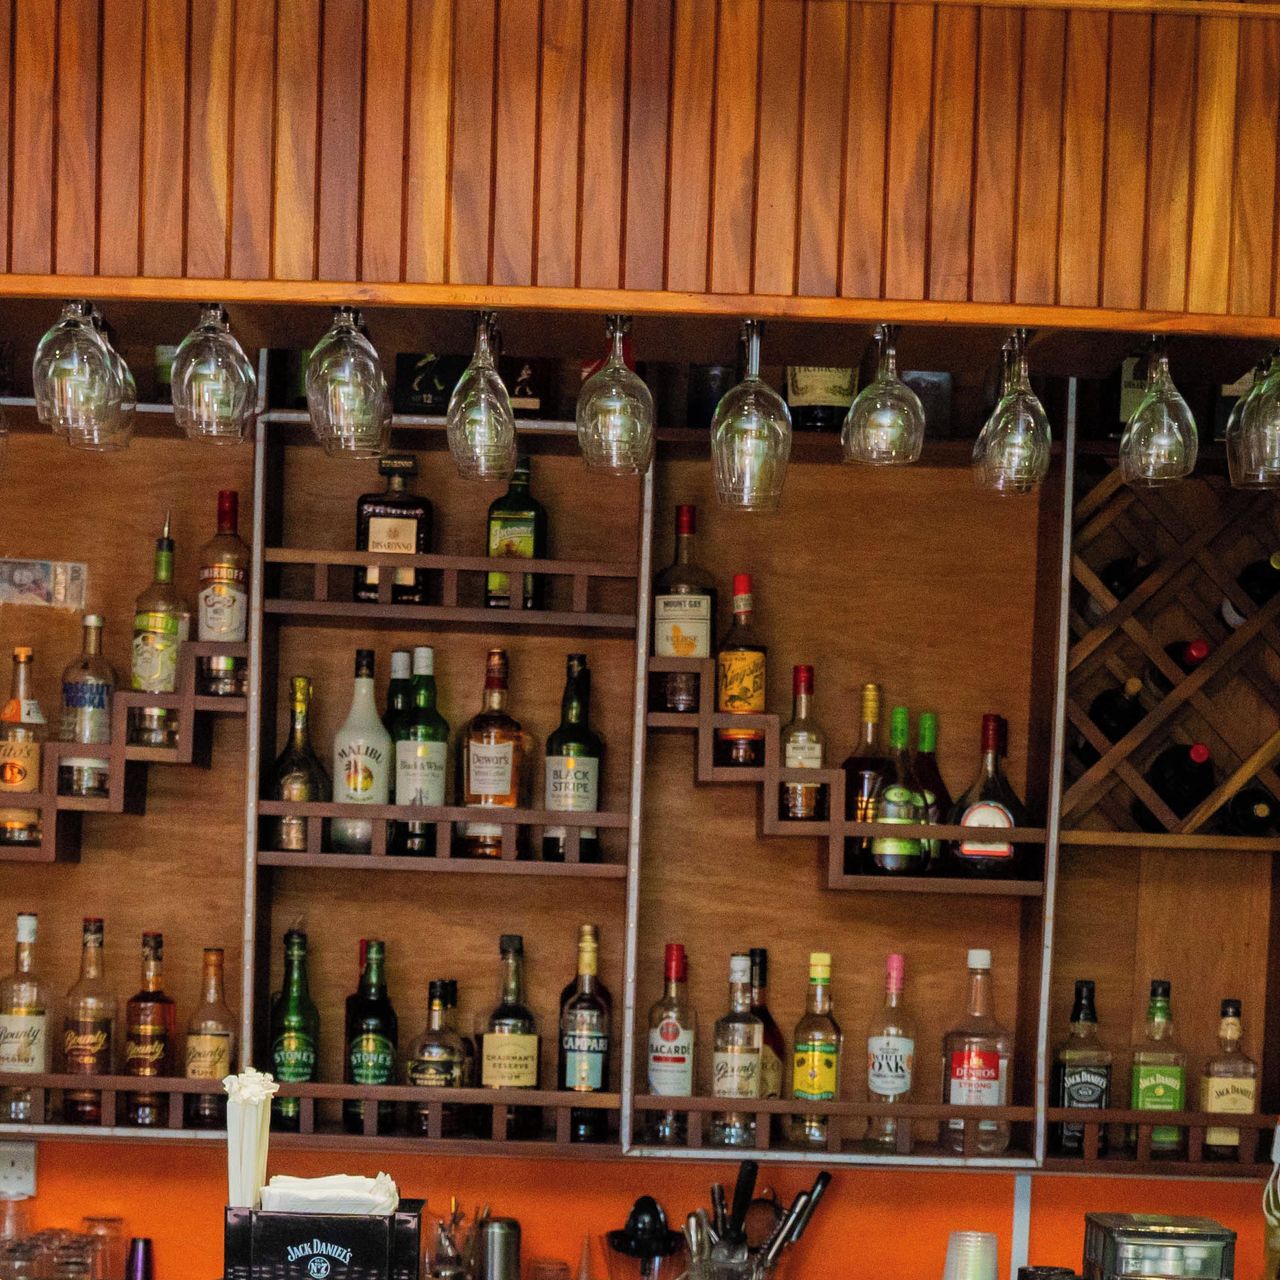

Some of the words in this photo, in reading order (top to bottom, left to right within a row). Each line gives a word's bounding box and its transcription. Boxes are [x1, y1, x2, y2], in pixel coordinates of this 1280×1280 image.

[371, 541, 413, 551] DISARONNO
[338, 744, 383, 764] MALIBU
[552, 770, 589, 780] BLACK
[552, 782, 589, 793] STRIPE
[872, 1061, 905, 1073] OAK
[1064, 1074, 1081, 1088] JACK
[1215, 1089, 1231, 1099] JACK
[286, 1242, 312, 1262] JACK
[312, 1238, 353, 1266] DANIEL'S
